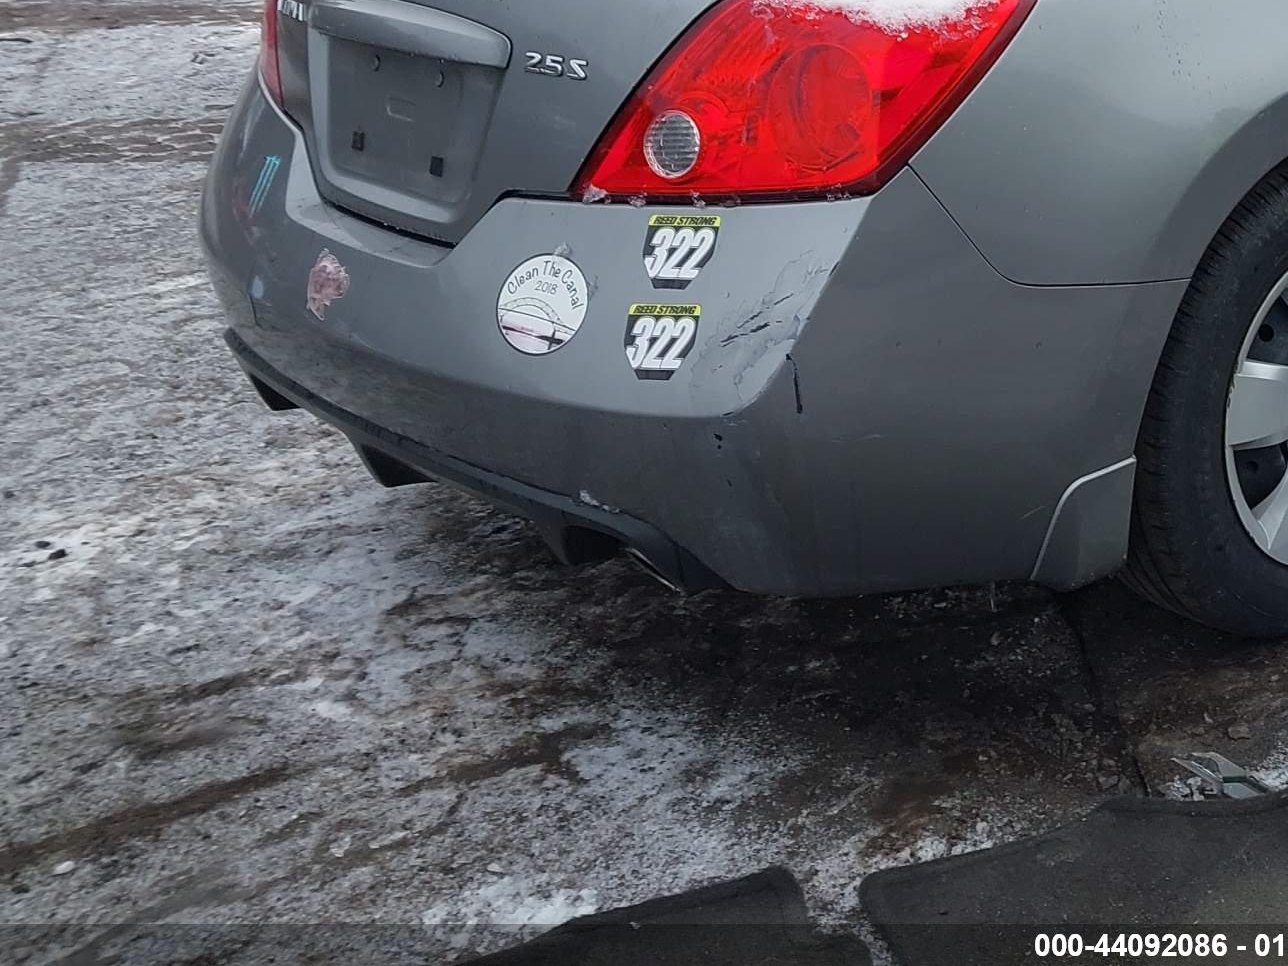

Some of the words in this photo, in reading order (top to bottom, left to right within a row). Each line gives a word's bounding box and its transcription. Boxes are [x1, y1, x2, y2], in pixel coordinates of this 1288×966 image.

[653, 216, 677, 225] REED
[677, 216, 717, 226] STRONG
[643, 226, 716, 279] 322
[507, 267, 539, 295] Clean
[543, 260, 562, 278] The
[561, 269, 584, 310] Canal
[534, 280, 558, 295] 2018
[633, 305, 657, 314] REED
[657, 305, 697, 315] STRONG
[625, 315, 697, 369] 322
